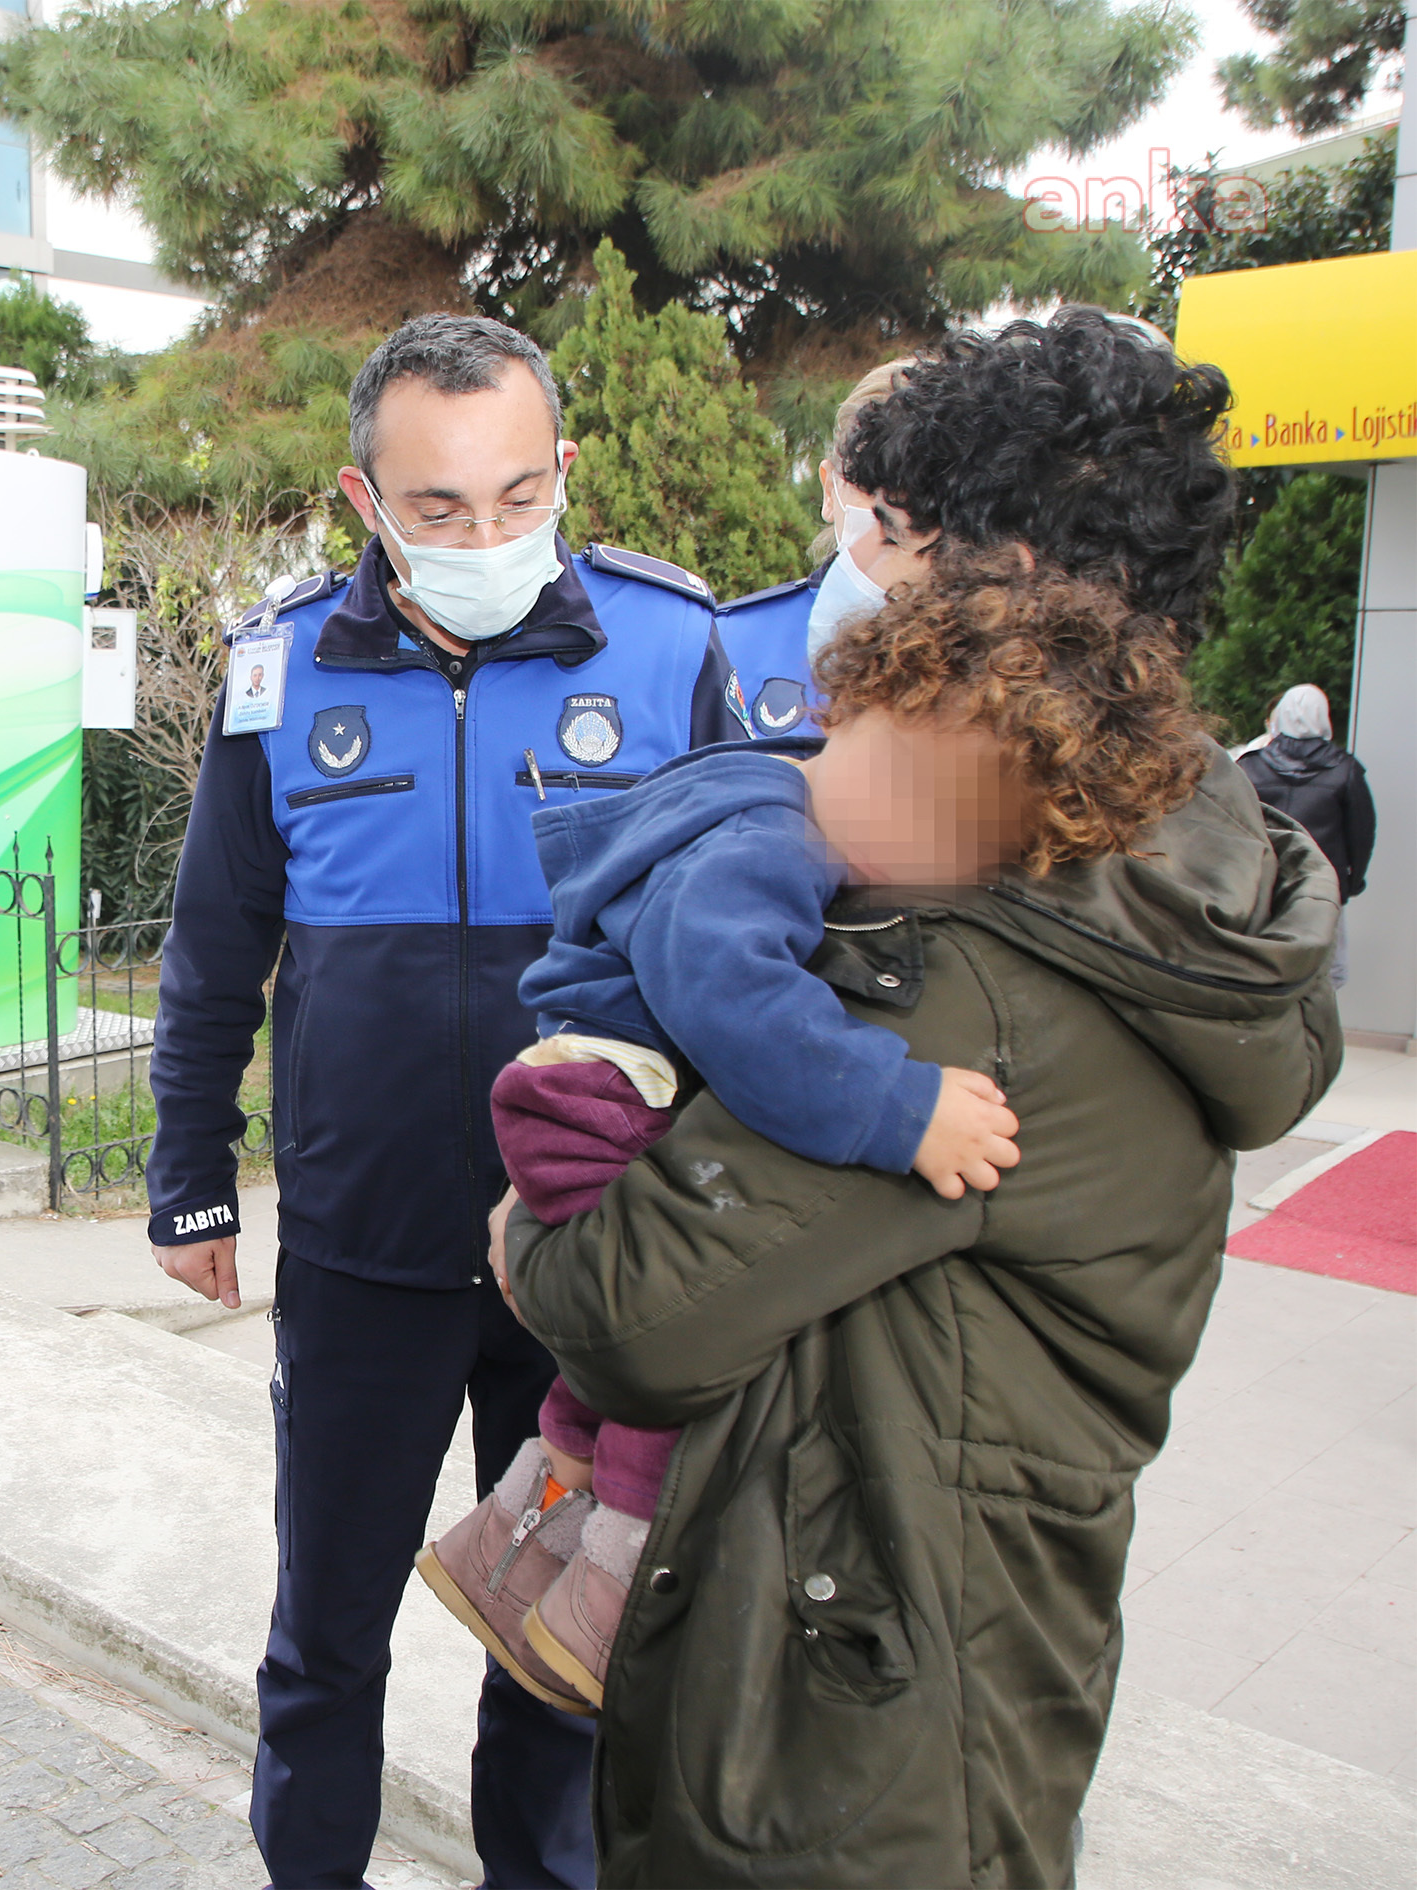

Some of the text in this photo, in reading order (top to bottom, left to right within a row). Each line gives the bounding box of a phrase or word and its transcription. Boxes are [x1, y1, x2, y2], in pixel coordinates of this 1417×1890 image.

[1266, 410, 1327, 447] Banka
[570, 698, 612, 708] ZABITA
[173, 1204, 234, 1236] ZABITA
